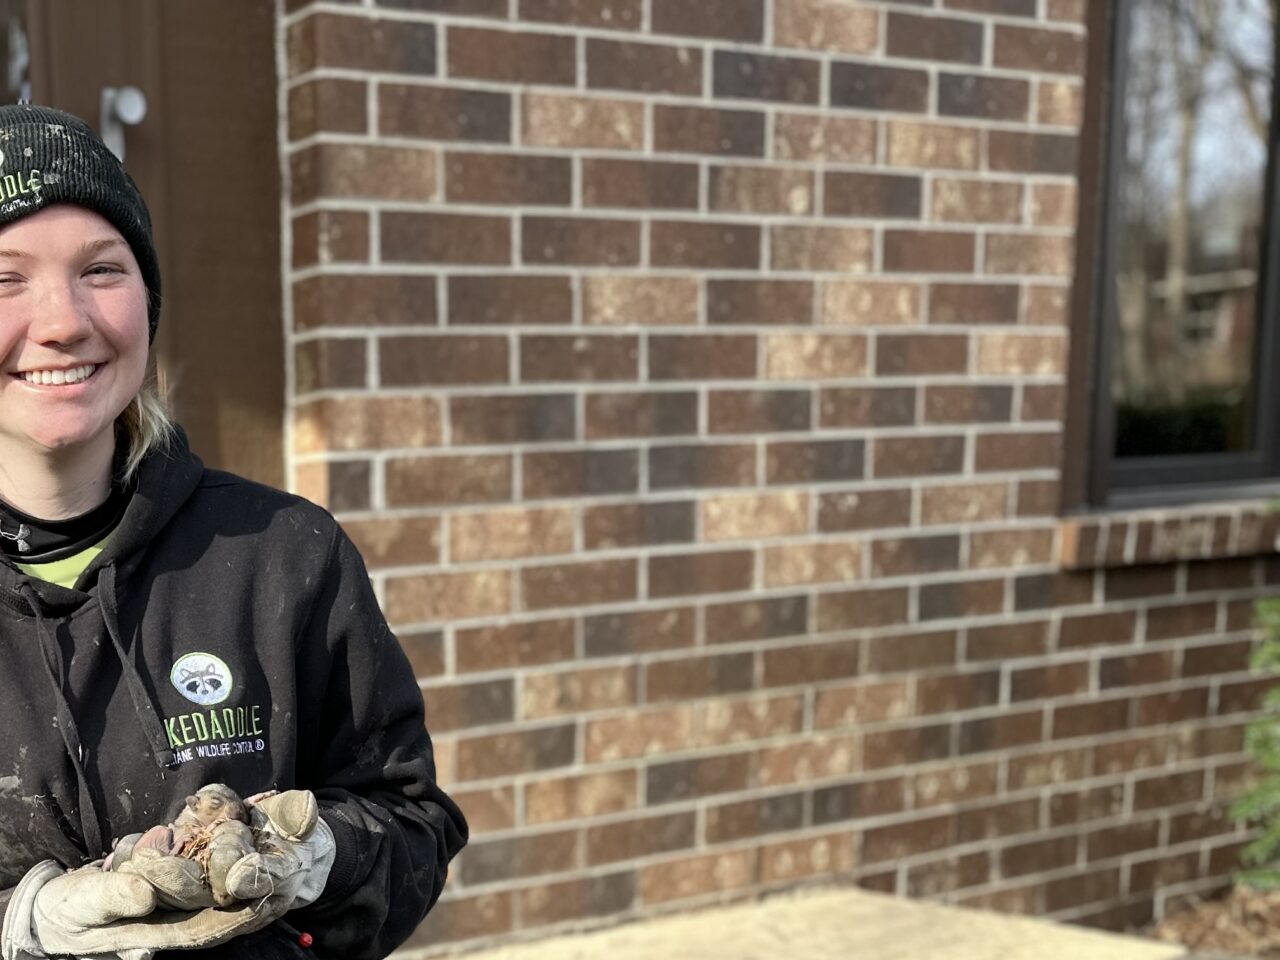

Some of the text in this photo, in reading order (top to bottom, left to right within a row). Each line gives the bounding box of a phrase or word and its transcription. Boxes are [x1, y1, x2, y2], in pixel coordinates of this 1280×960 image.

[164, 705, 263, 749] KEDADDLE
[166, 748, 194, 767] ANE
[196, 742, 231, 758] WILDLIFE
